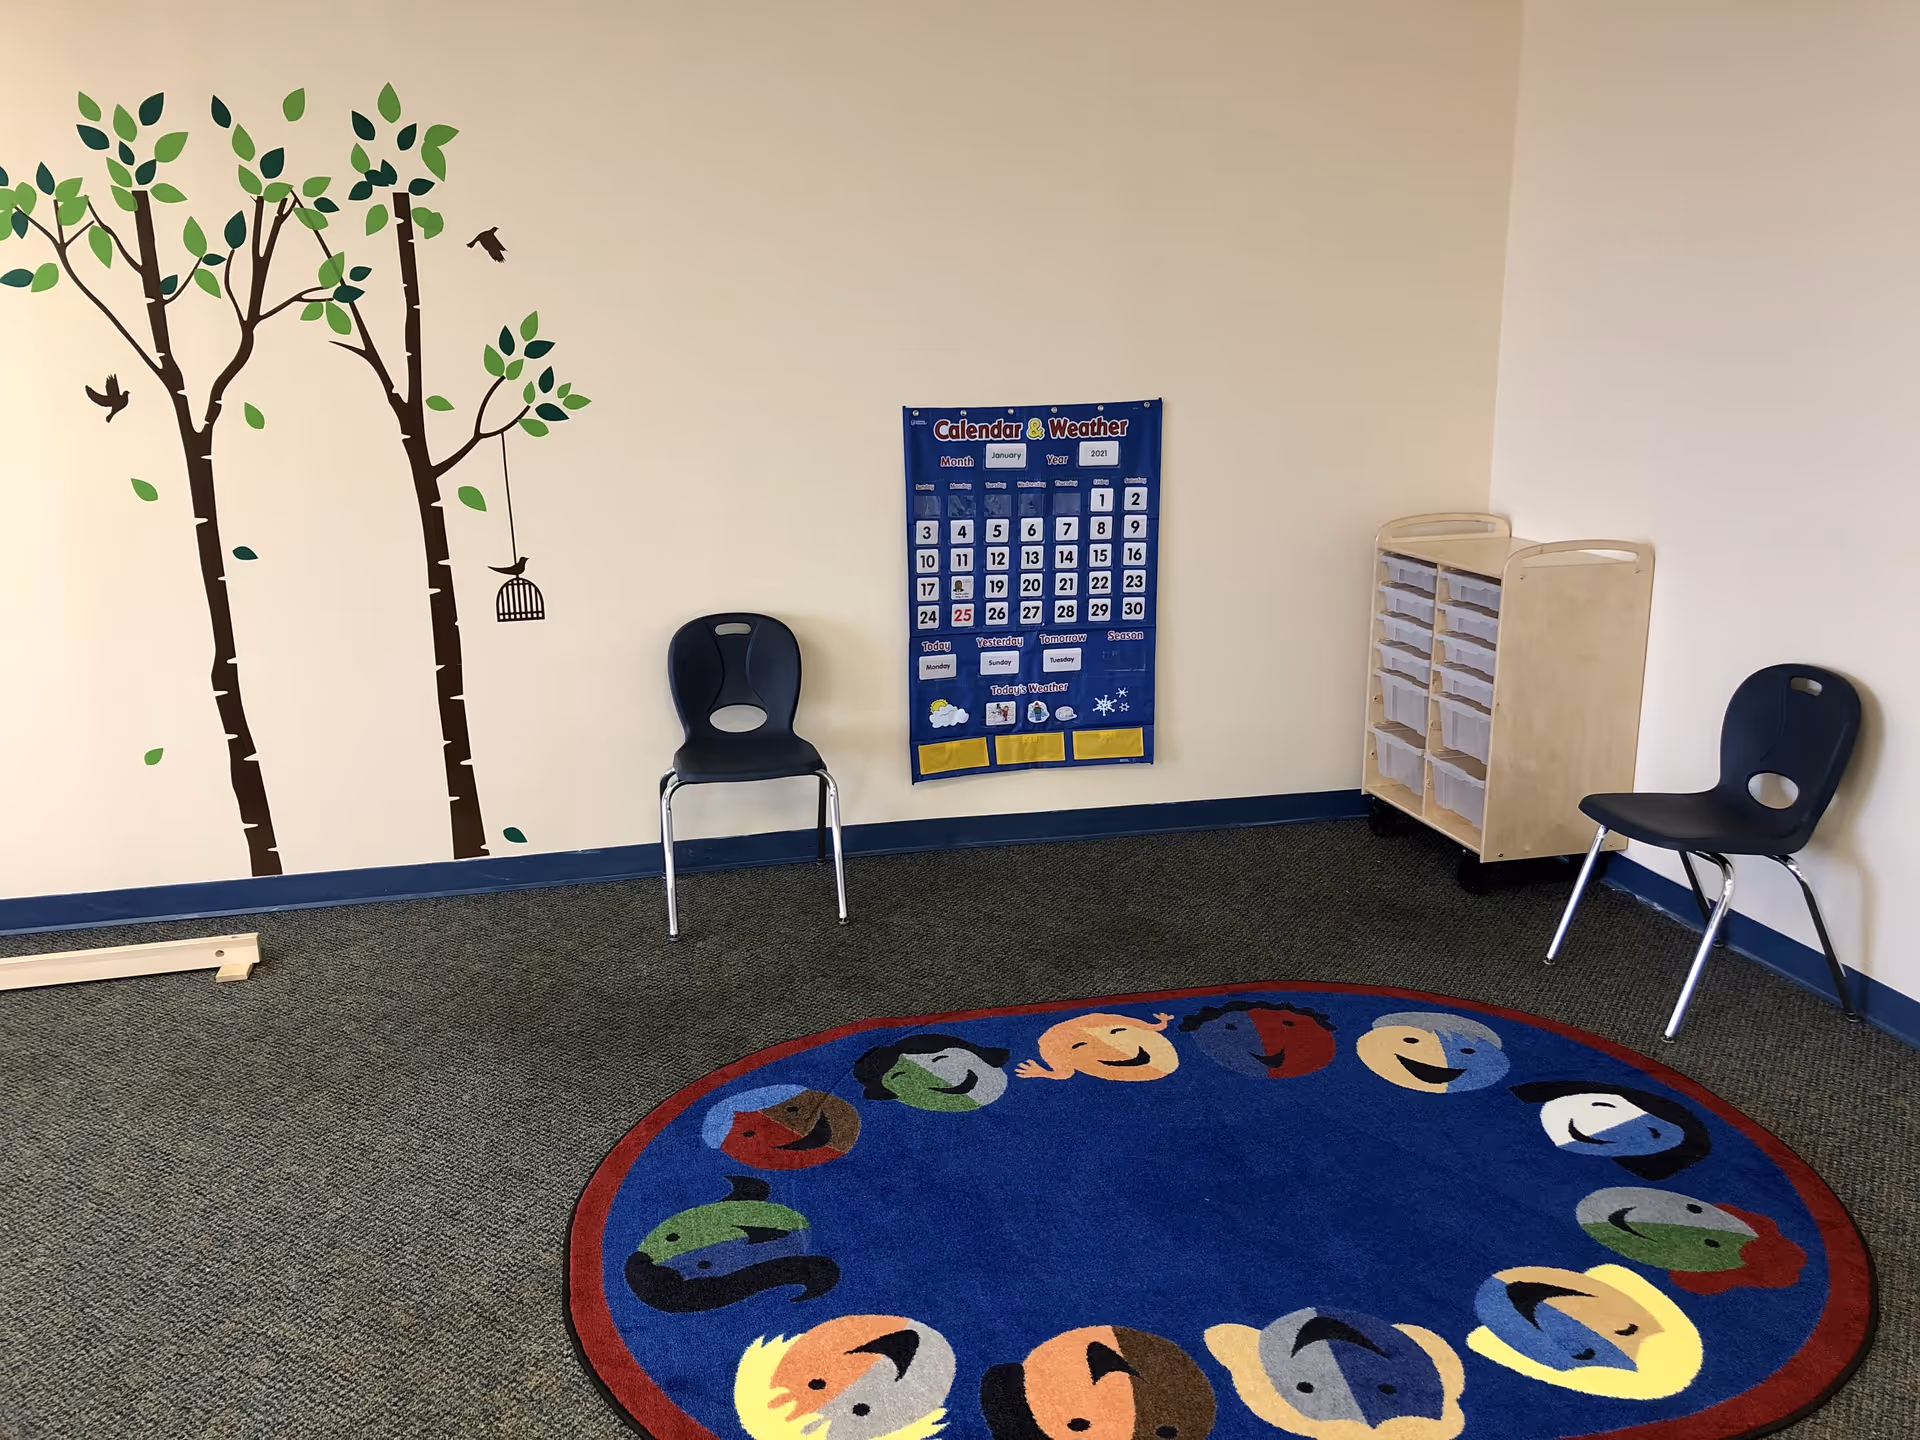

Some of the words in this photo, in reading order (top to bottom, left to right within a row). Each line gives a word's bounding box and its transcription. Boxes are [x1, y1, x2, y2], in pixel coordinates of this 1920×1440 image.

[934, 418, 1023, 442] Calendar
[1026, 418, 1045, 440] &
[1048, 416, 1129, 439] Weather
[940, 456, 975, 467] Month
[991, 452, 1021, 460] January
[1046, 454, 1068, 465] Year
[949, 482, 972, 490] Monday
[1099, 494, 1105, 506] 1
[1131, 493, 1140, 505] 2
[923, 527, 931, 539] 3
[958, 526, 967, 538] 4
[993, 525, 1001, 538] 5
[1028, 524, 1036, 536] 6
[1063, 523, 1072, 536] 7
[1097, 522, 1105, 534] 8
[1131, 521, 1140, 534] 9
[920, 555, 935, 568] 10
[956, 554, 967, 566] 11
[991, 552, 1005, 565] 12
[1025, 551, 1039, 564] 13
[1059, 551, 1074, 564] 14
[1093, 550, 1107, 562] 15
[1128, 548, 1142, 561] 16
[921, 583, 935, 596] 17
[990, 580, 1004, 593] 19
[1022, 579, 1040, 591] 20
[1059, 578, 1073, 591] 21
[1091, 576, 1109, 589] 22
[1126, 575, 1143, 588] 23
[920, 611, 936, 624] 24
[954, 609, 971, 622] 25
[988, 608, 1005, 620] 26
[1022, 606, 1040, 619] 27
[1057, 606, 1074, 618] 28
[1091, 604, 1108, 616] 29
[1124, 602, 1143, 615] 30
[1040, 634, 1087, 644] Tomorrow
[1108, 630, 1144, 641] Season
[922, 640, 951, 652] Today
[976, 636, 1024, 647] Yesterday
[926, 663, 950, 671] Monday
[990, 685, 1026, 696] Today's
[1029, 682, 1068, 693] Weather
